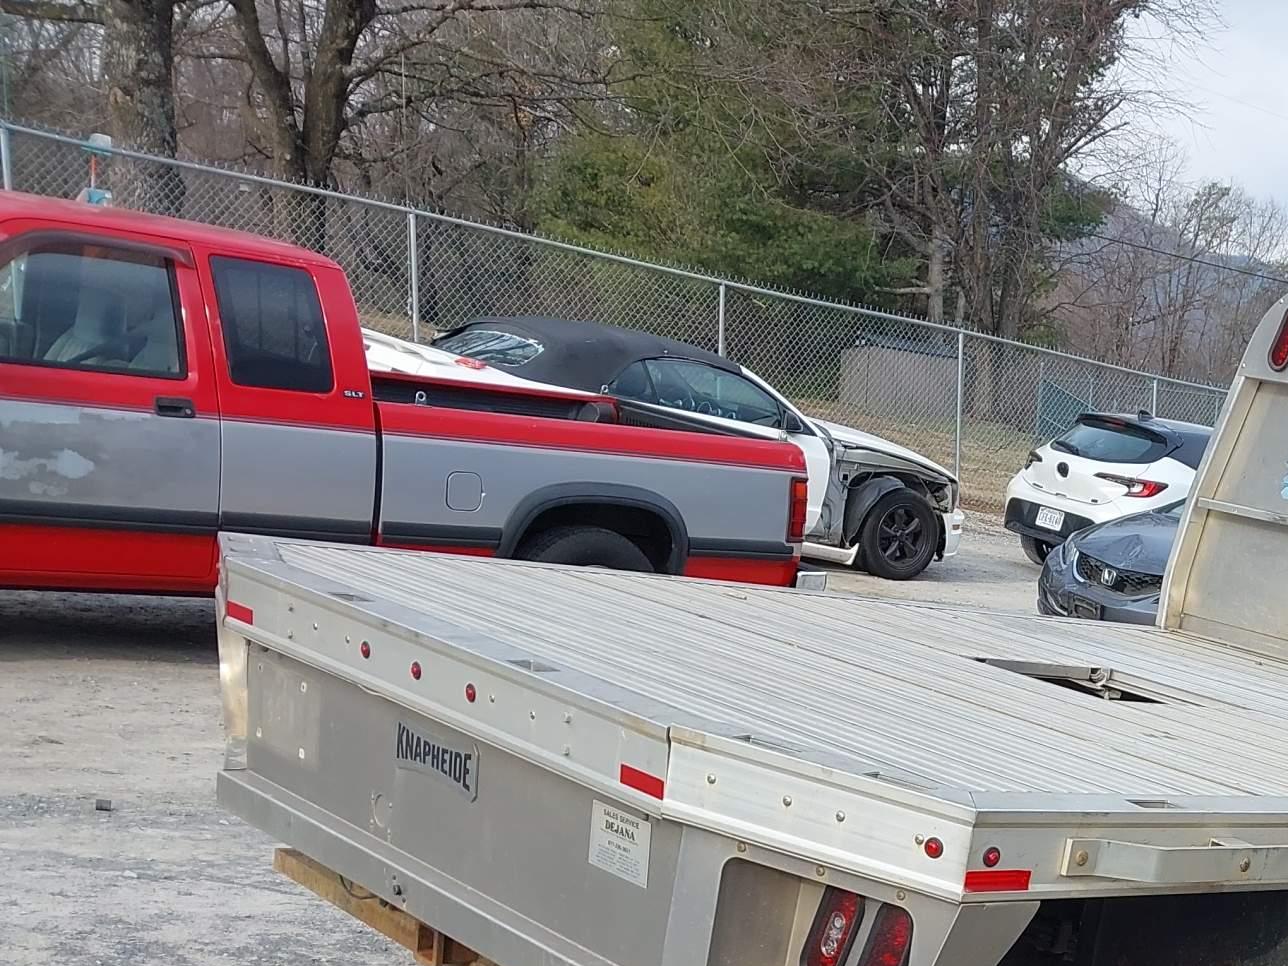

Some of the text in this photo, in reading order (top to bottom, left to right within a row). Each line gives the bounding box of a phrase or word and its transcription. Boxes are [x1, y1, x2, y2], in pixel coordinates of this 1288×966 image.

[344, 390, 363, 398] SLT
[397, 722, 472, 792] KNAPHEIDE
[603, 808, 640, 829] SALES SERVICE
[605, 819, 636, 842] DEJANA
